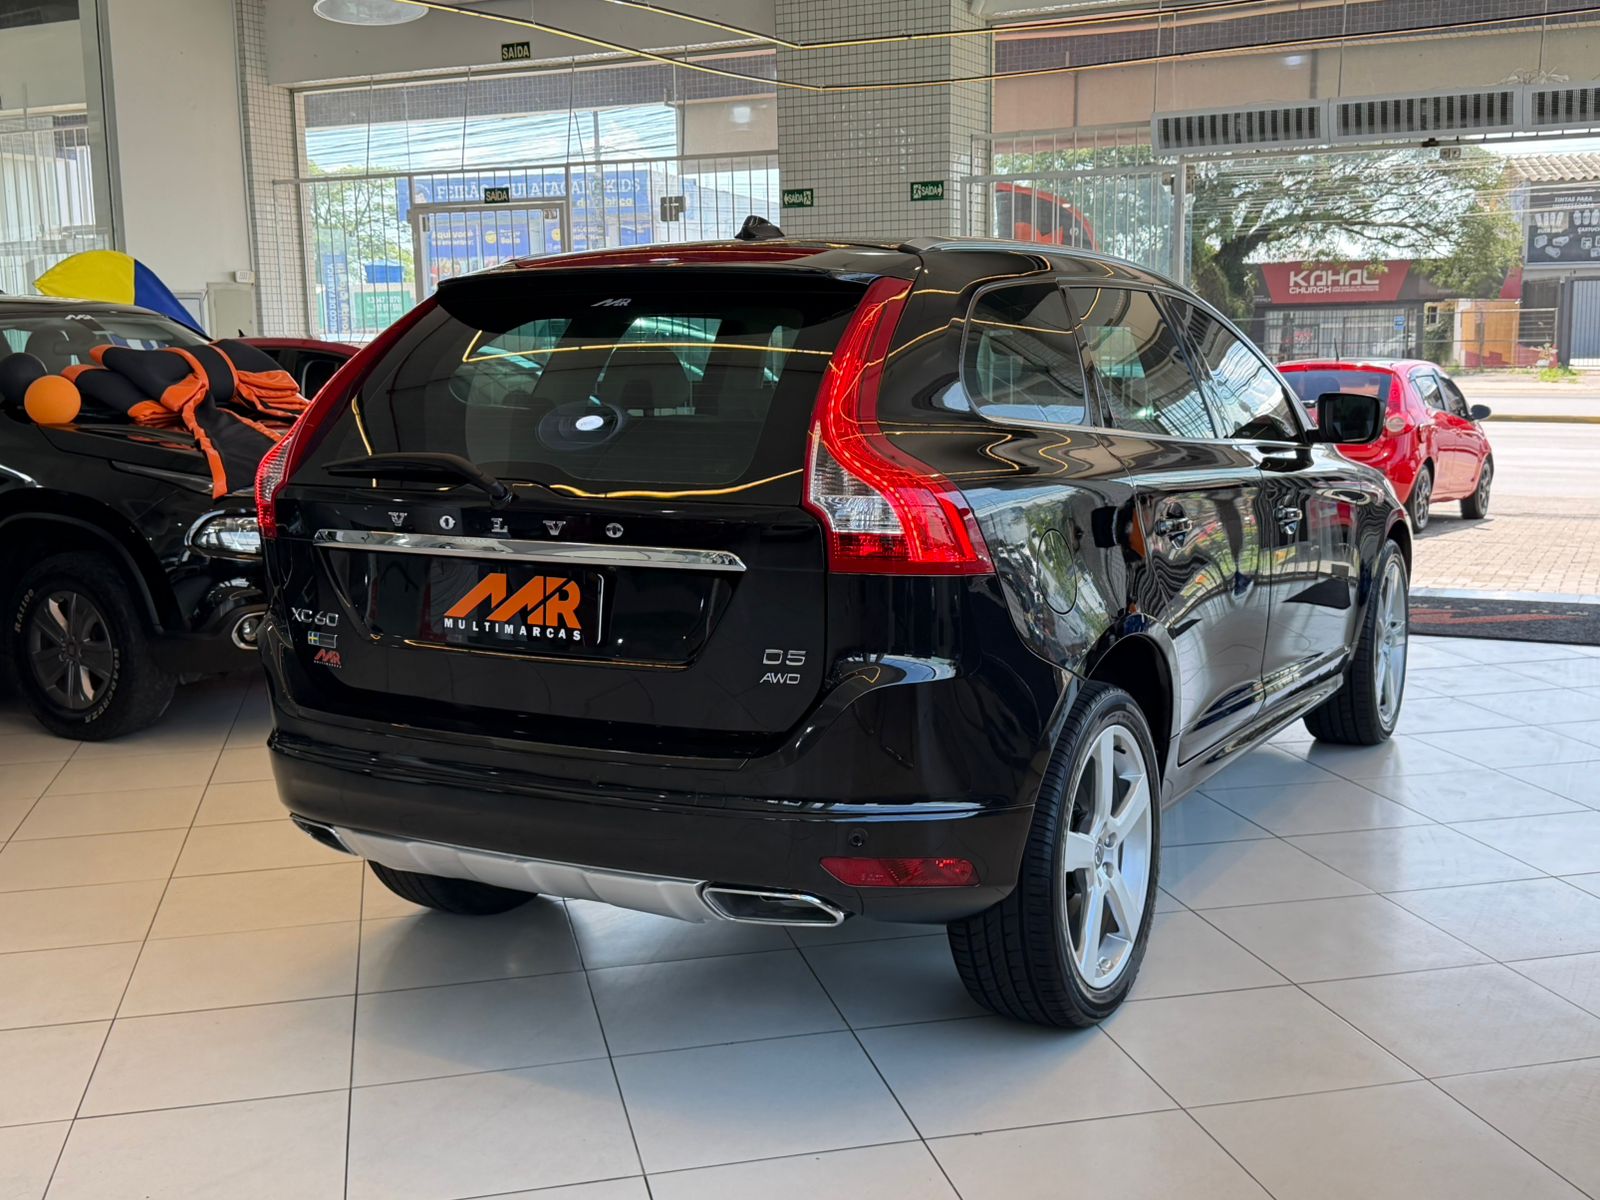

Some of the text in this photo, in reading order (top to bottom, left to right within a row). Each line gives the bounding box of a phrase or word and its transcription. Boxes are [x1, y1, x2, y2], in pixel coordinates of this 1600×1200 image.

[502, 43, 530, 59] SAÍDA
[485, 189, 508, 202] SAÍDA
[789, 192, 804, 202] SAÍDA
[921, 185, 938, 197] SAÍDA
[1289, 267, 1380, 287] KAHAL
[1289, 285, 1332, 295] CHURCH
[388, 511, 625, 539] VOLVO
[443, 617, 582, 641] MULTIMARCAS
[762, 649, 806, 666] D5
[759, 672, 801, 684] AWD
